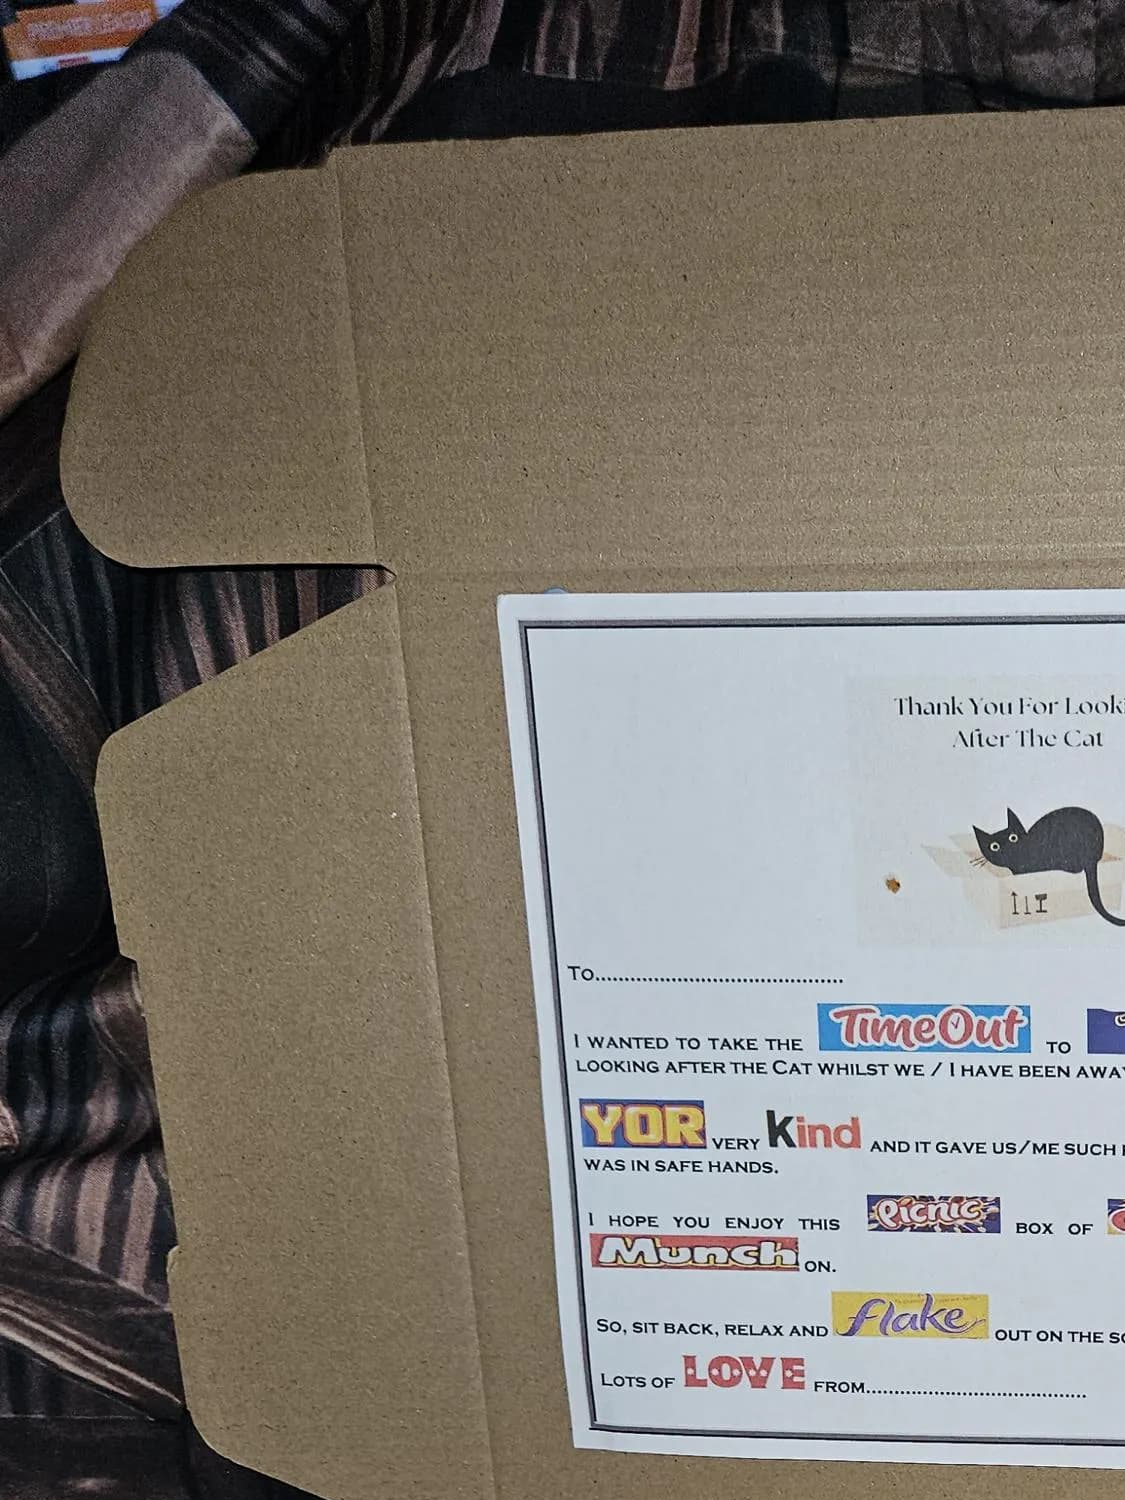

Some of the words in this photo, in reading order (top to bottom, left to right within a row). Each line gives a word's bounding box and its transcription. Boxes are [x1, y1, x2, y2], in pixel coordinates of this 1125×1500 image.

[894, 696, 963, 715] Thank
[969, 697, 1013, 715] You
[1019, 697, 1058, 715] For
[952, 728, 1010, 748] After
[1016, 728, 1057, 747] The
[1064, 729, 1104, 747] Cat
[574, 1034, 580, 1048] I
[830, 1006, 1026, 1049] TimeOut
[931, 1062, 942, 1076] /
[949, 1062, 955, 1077] I
[581, 1103, 706, 1147] YOR
[588, 1212, 594, 1226] I
[876, 1196, 983, 1228] Picnic
[599, 1236, 799, 1268] Munch
[682, 1355, 805, 1390] LOVE
